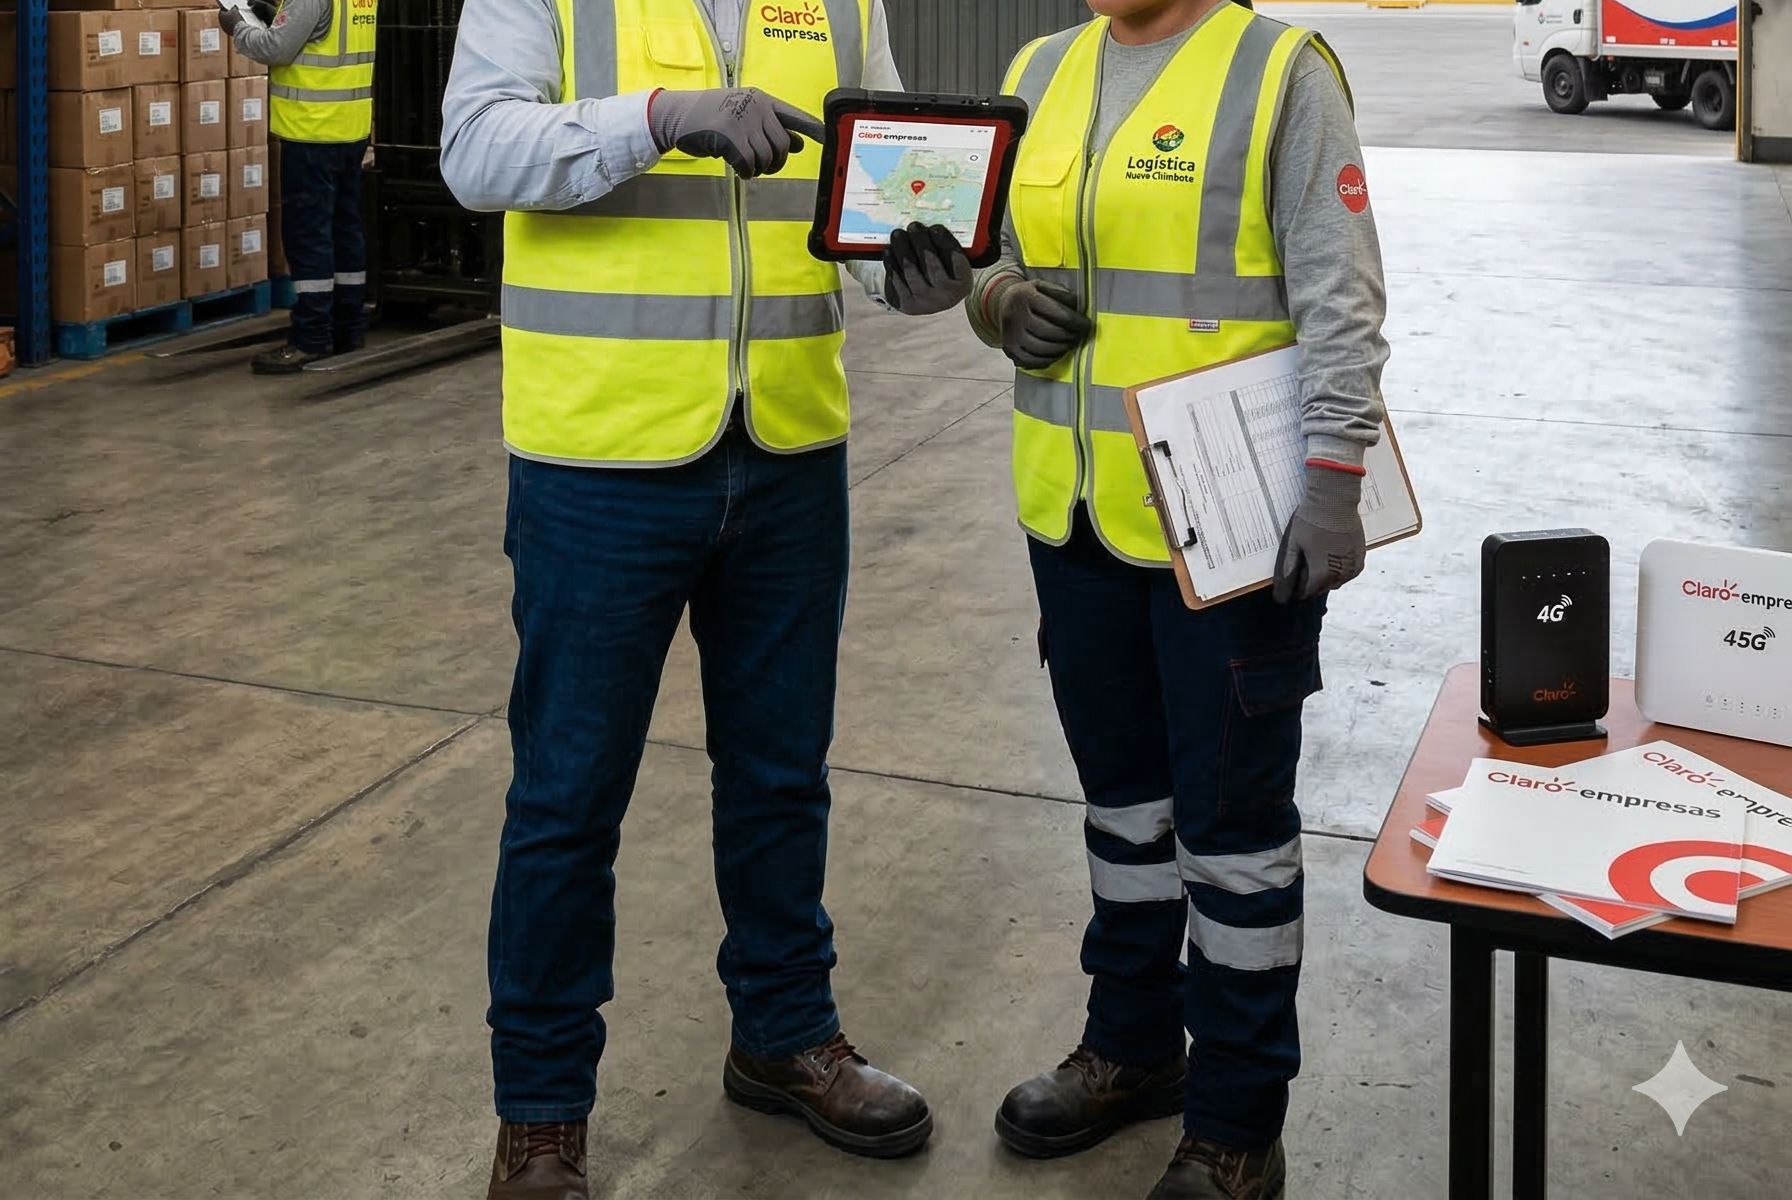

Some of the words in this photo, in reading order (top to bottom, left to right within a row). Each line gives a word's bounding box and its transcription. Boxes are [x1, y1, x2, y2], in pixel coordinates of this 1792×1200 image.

[760, 2, 825, 26] Claro
[763, 27, 828, 42] empresas
[1127, 154, 1196, 173] Logística
[1125, 171, 1151, 180] Nuevo
[1682, 579, 1740, 601] Claro
[1537, 604, 1565, 623] 4G
[1723, 629, 1767, 651] 45G
[1533, 684, 1574, 702] Claro
[1643, 751, 1724, 788] Claro
[1487, 771, 1578, 793] Claro
[1580, 787, 1722, 819] empresas
